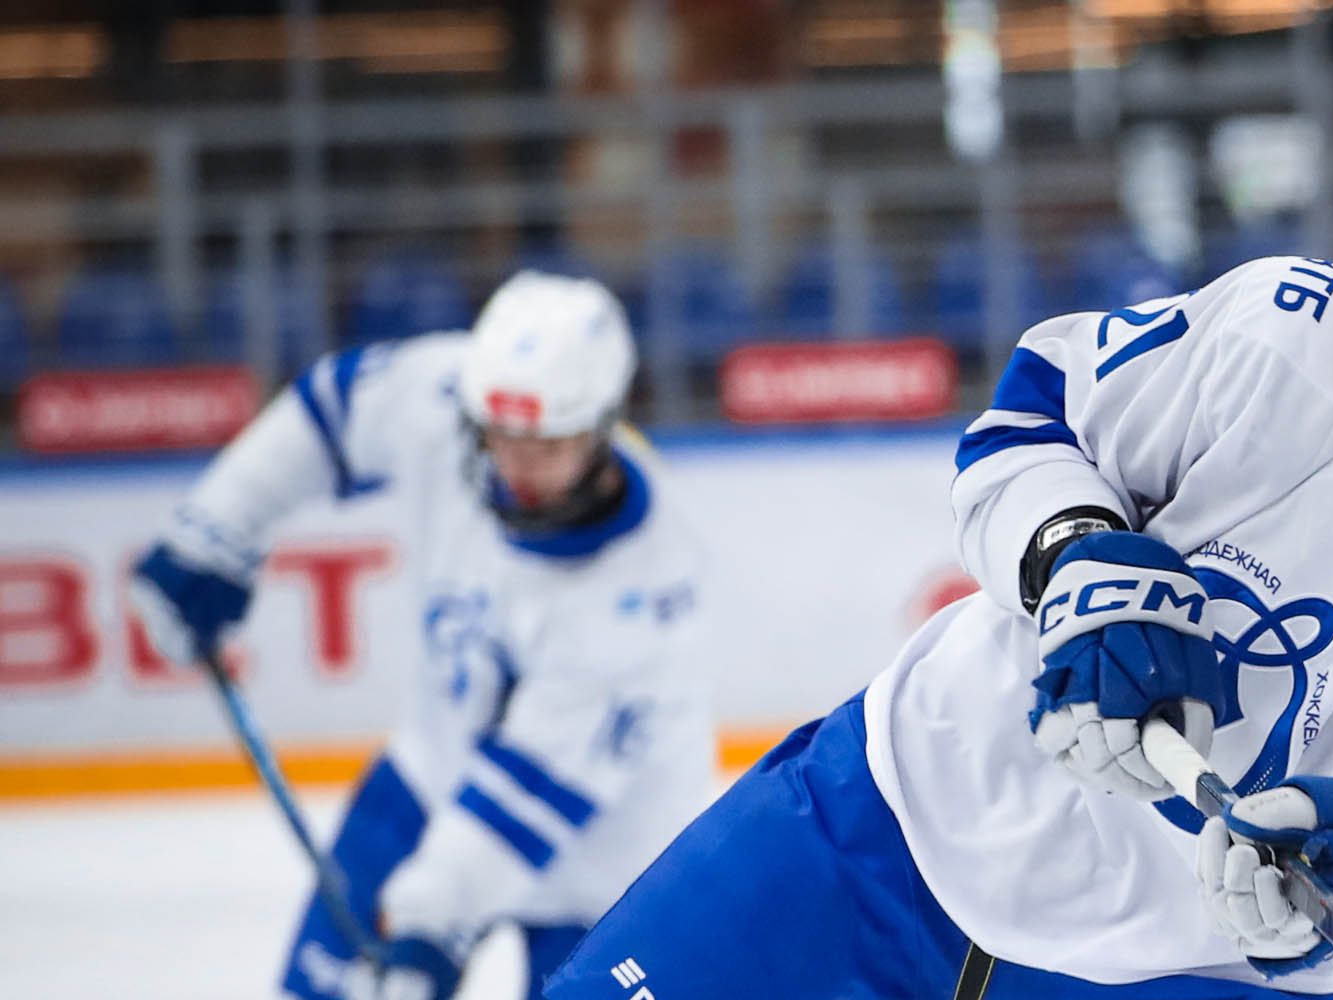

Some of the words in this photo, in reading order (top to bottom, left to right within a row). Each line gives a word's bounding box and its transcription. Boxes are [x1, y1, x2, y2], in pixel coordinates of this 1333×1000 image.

[1200, 540, 1282, 595] ДЕЖНАЯ
[1040, 579, 1206, 637] CCM
[1303, 670, 1329, 753] ХОККЕ
